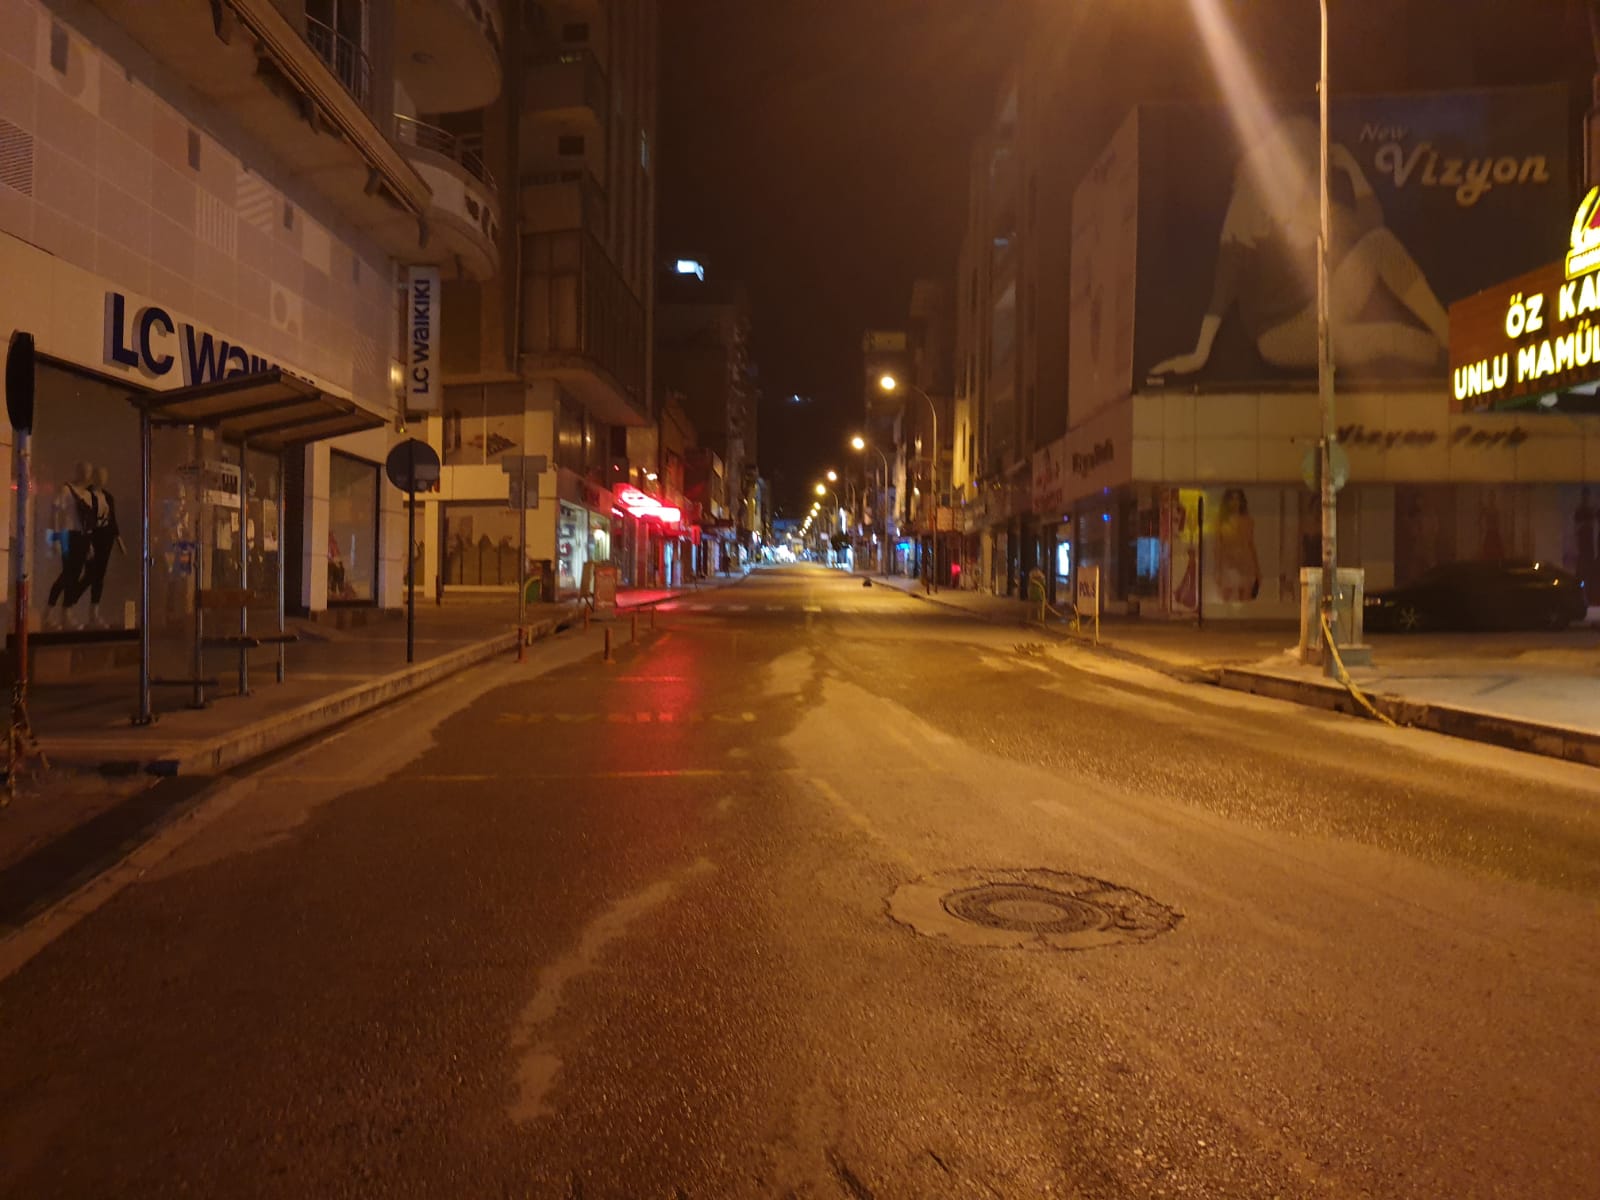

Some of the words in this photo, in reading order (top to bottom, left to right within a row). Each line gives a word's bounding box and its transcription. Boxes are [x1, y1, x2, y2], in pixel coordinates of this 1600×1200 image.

[1375, 141, 1549, 207] Vizyon
[106, 291, 175, 377] LC
[1506, 292, 1544, 339] ÖZ
[1559, 271, 1600, 322] KA
[413, 367, 429, 394] LC
[1454, 352, 1508, 400] UNLU
